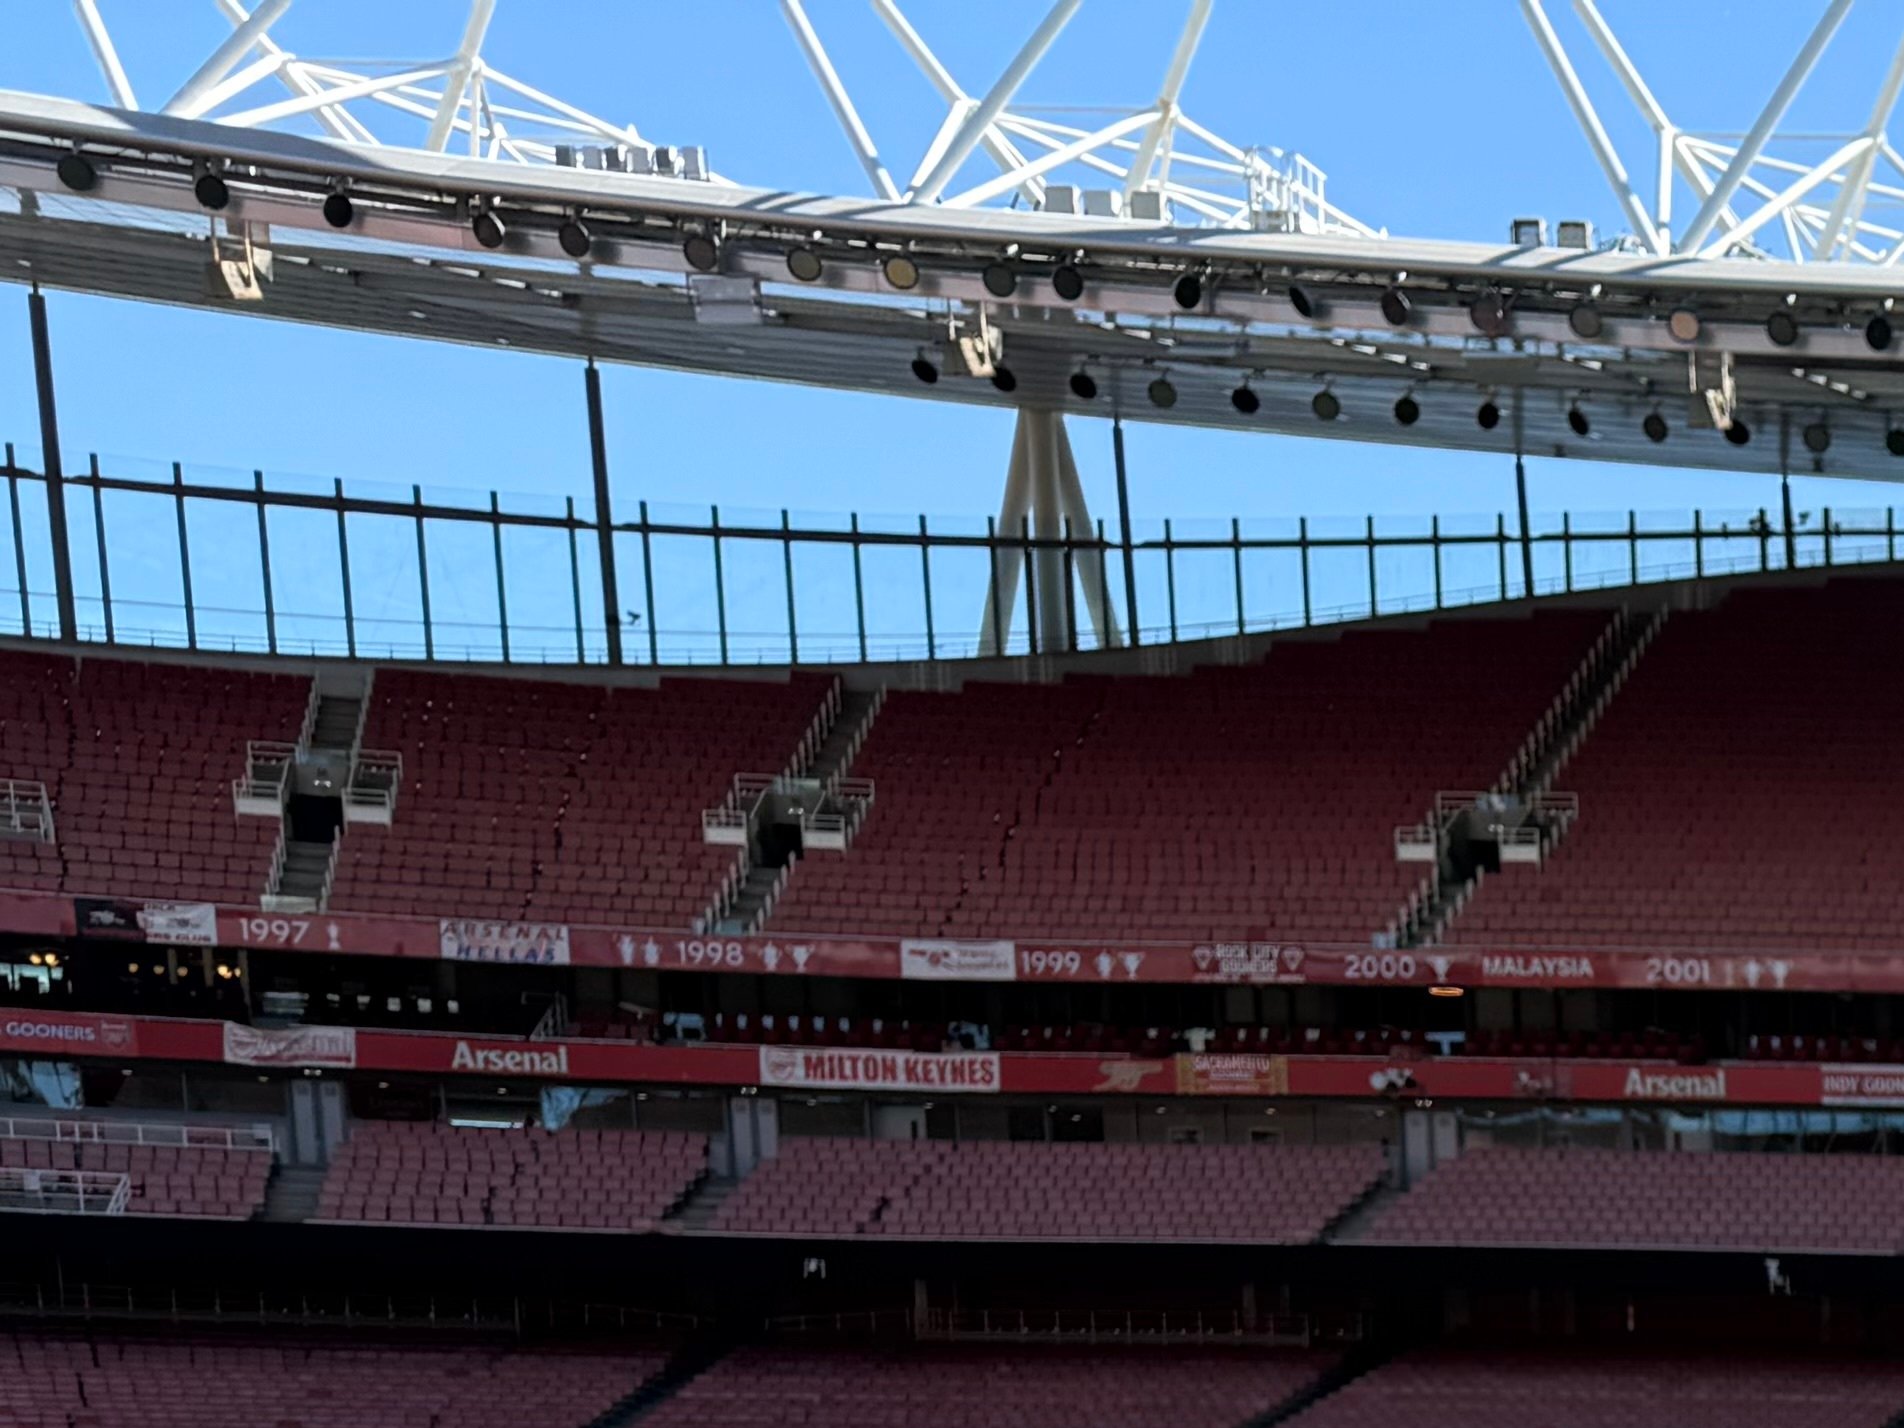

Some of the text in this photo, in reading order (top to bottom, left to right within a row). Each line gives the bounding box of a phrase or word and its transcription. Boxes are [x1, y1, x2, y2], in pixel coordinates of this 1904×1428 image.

[239, 917, 311, 945] 1997
[443, 921, 566, 942] ARSENAL
[677, 940, 745, 966] 1998
[1021, 950, 1081, 975] 1999
[1344, 955, 1417, 980] 2000
[1482, 956, 1594, 978] MALAYSIA
[1647, 958, 1710, 984] 2001
[6, 1021, 96, 1042] GOONERS
[451, 1040, 568, 1073] Arsenal
[803, 1054, 995, 1086] MILTON KEYNES
[1624, 1069, 1726, 1097] Arsenal
